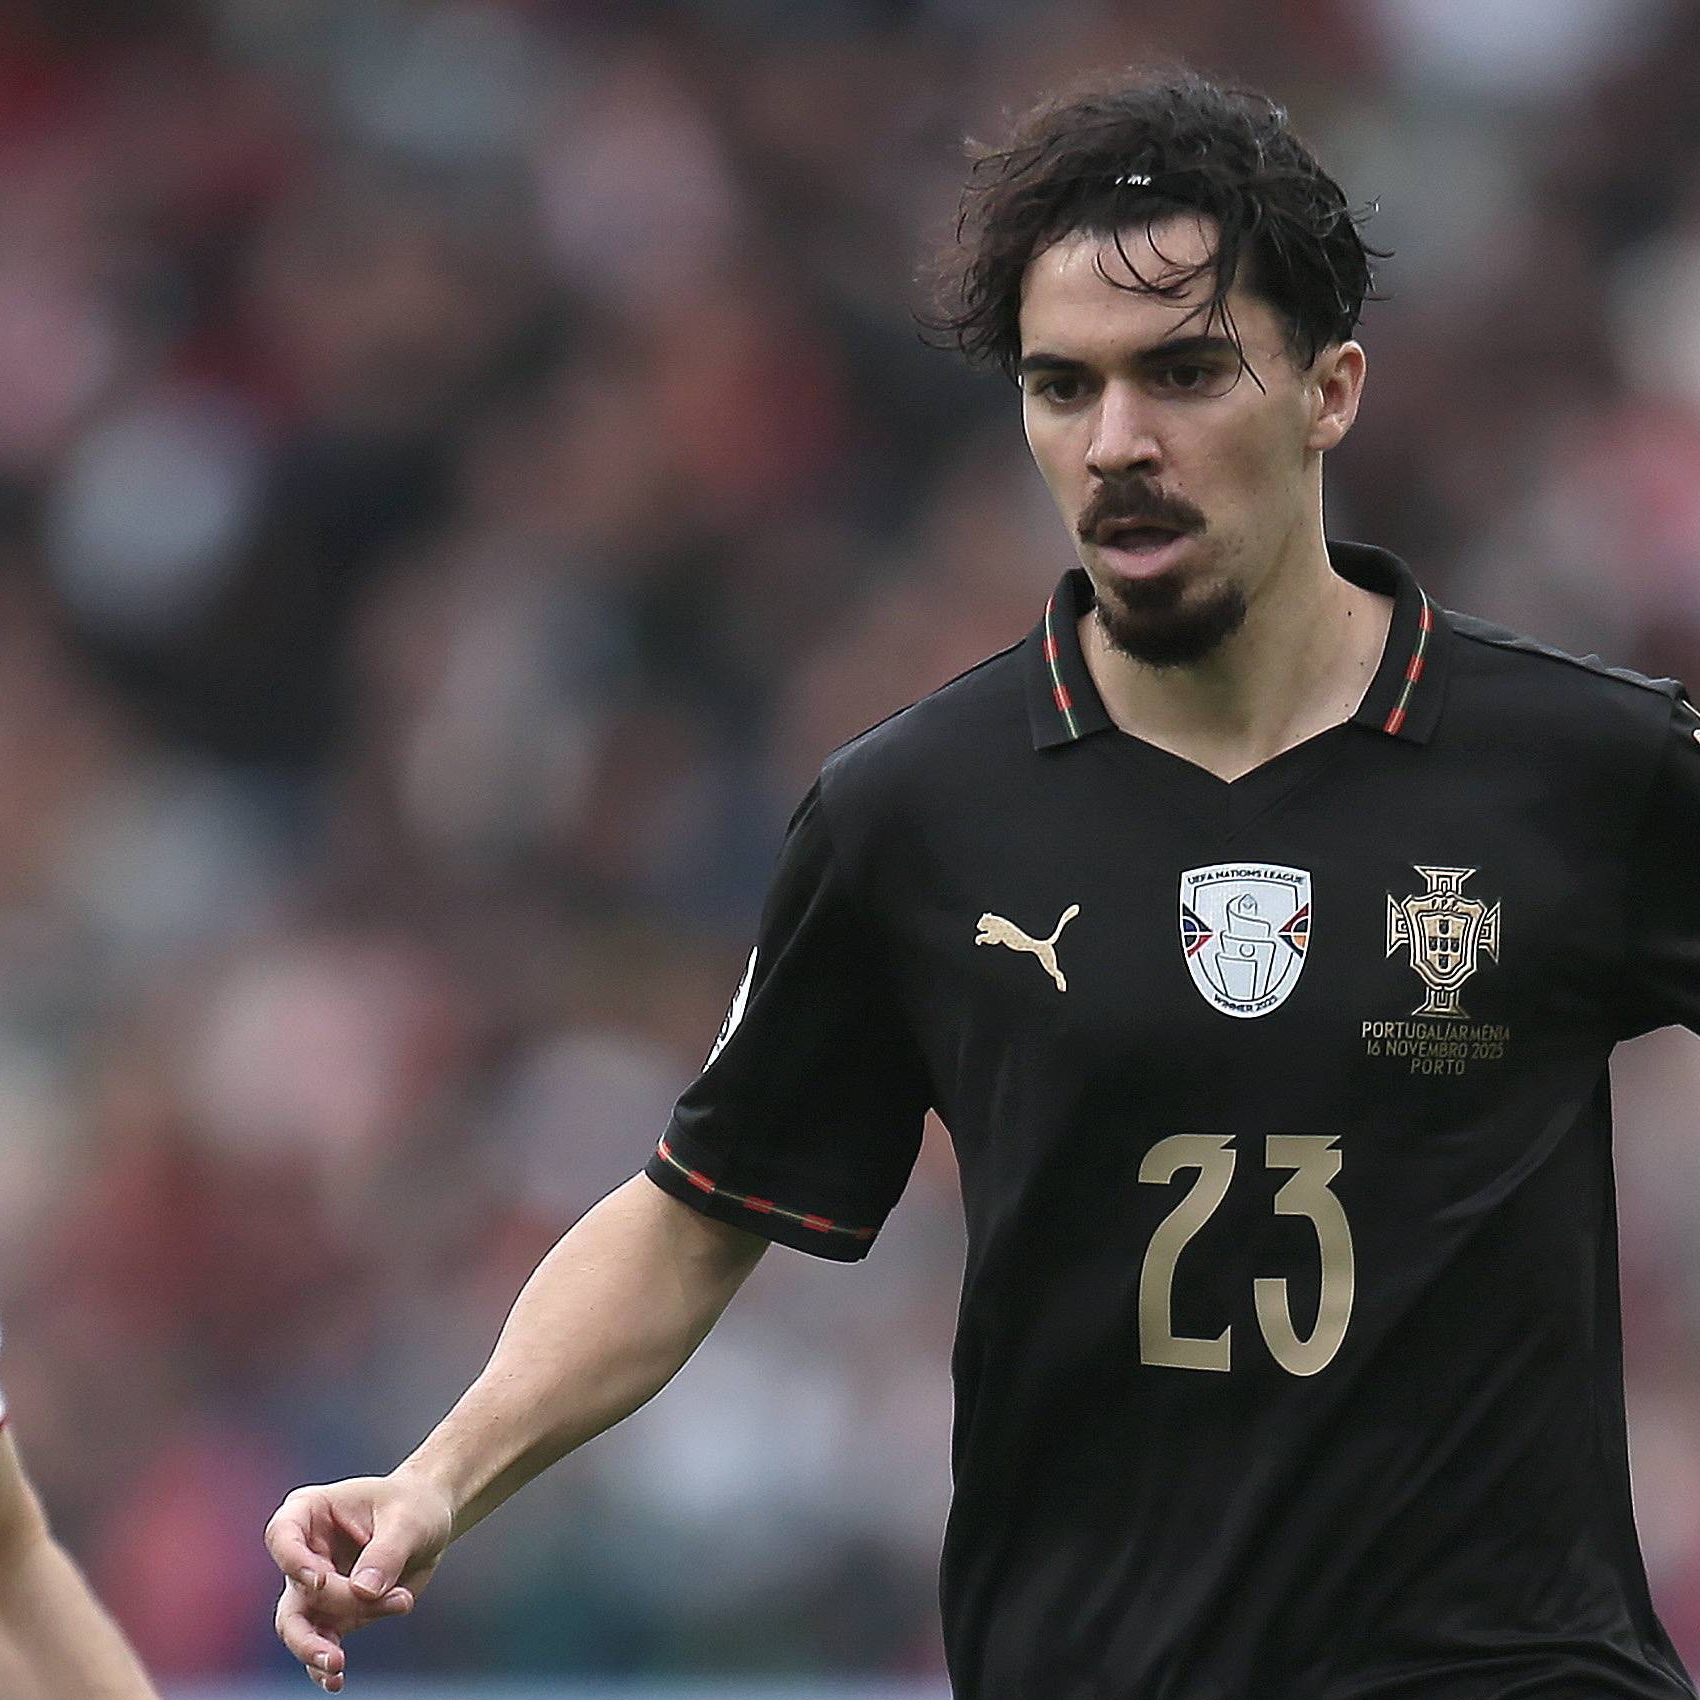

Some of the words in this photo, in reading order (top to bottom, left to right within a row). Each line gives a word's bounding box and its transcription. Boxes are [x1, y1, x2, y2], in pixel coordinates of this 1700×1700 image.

[1188, 873, 1213, 885] UEFA
[1215, 869, 1261, 880] NATIONS
[1263, 870, 1304, 885] LEAGUE
[1367, 1040, 1381, 1056] 16
[1385, 1040, 1468, 1059] NOVEMBRO
[1410, 1058, 1466, 1075] PORTO
[1138, 1133, 1355, 1377] 23
